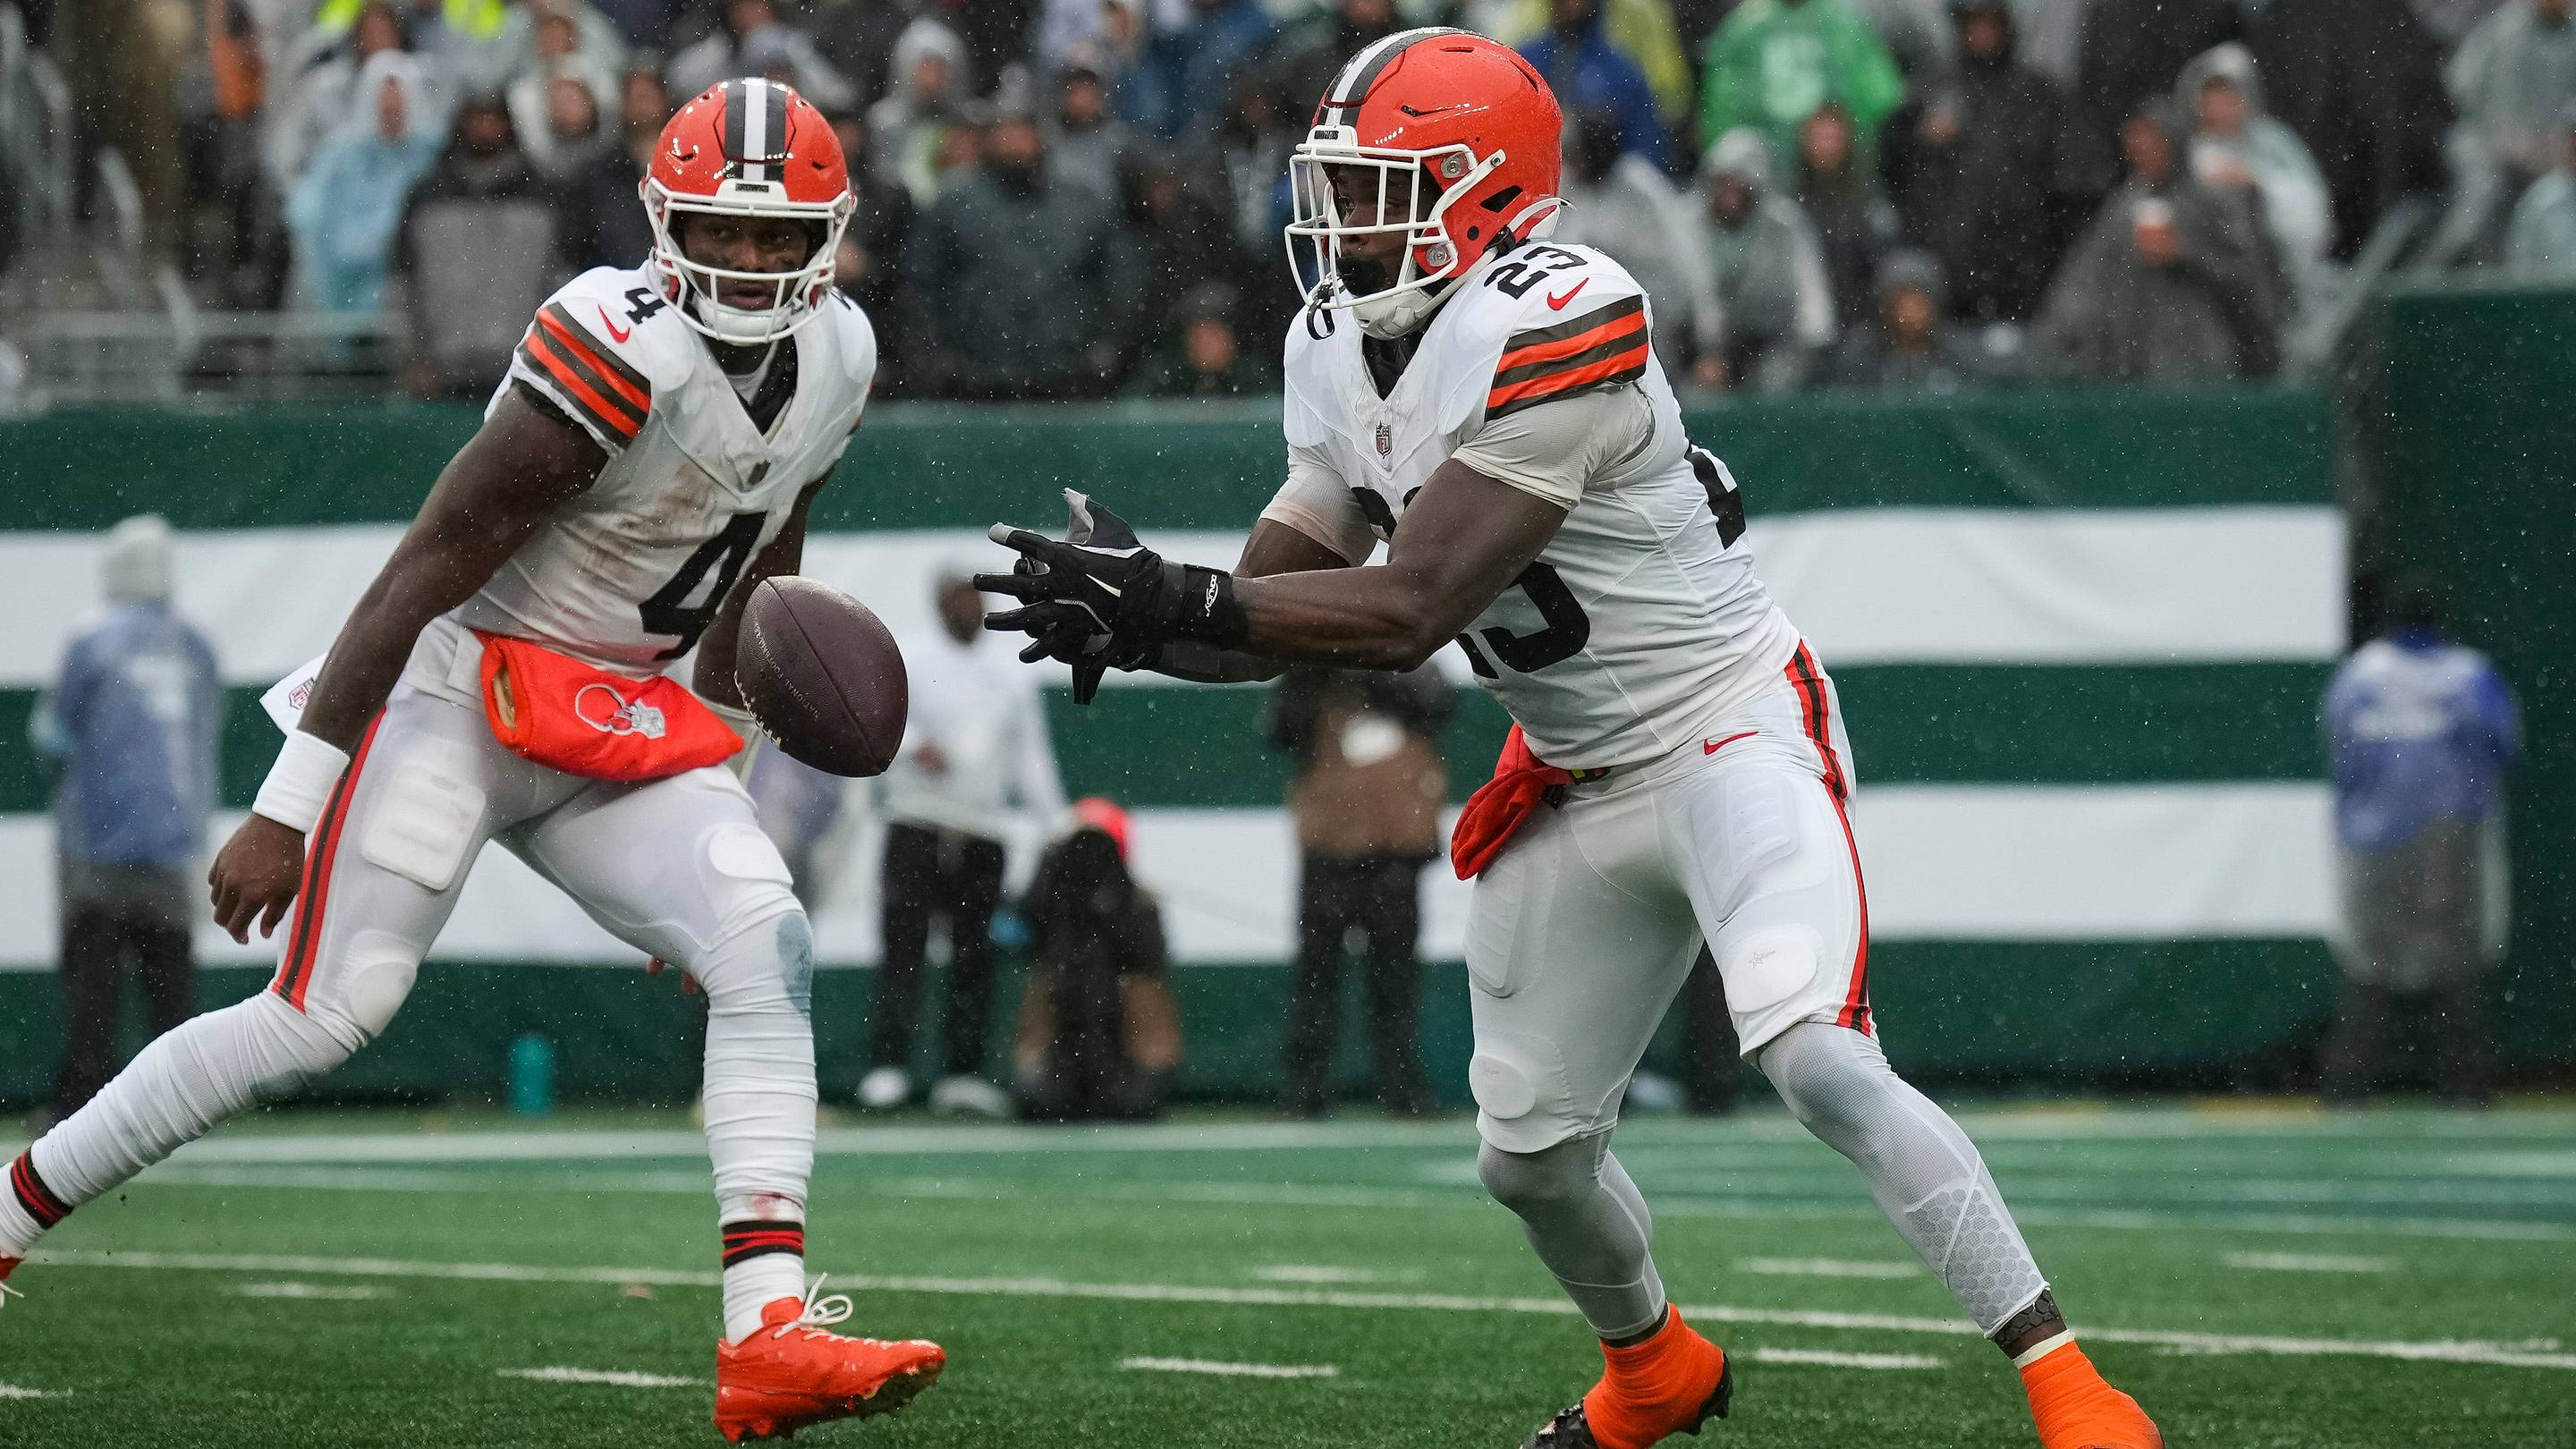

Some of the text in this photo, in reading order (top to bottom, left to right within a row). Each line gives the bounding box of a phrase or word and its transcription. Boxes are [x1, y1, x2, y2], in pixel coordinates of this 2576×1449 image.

[1484, 246, 1588, 300] 23
[625, 287, 666, 325] 4
[638, 511, 768, 661] 4
[785, 679, 820, 718] NATIONAL
